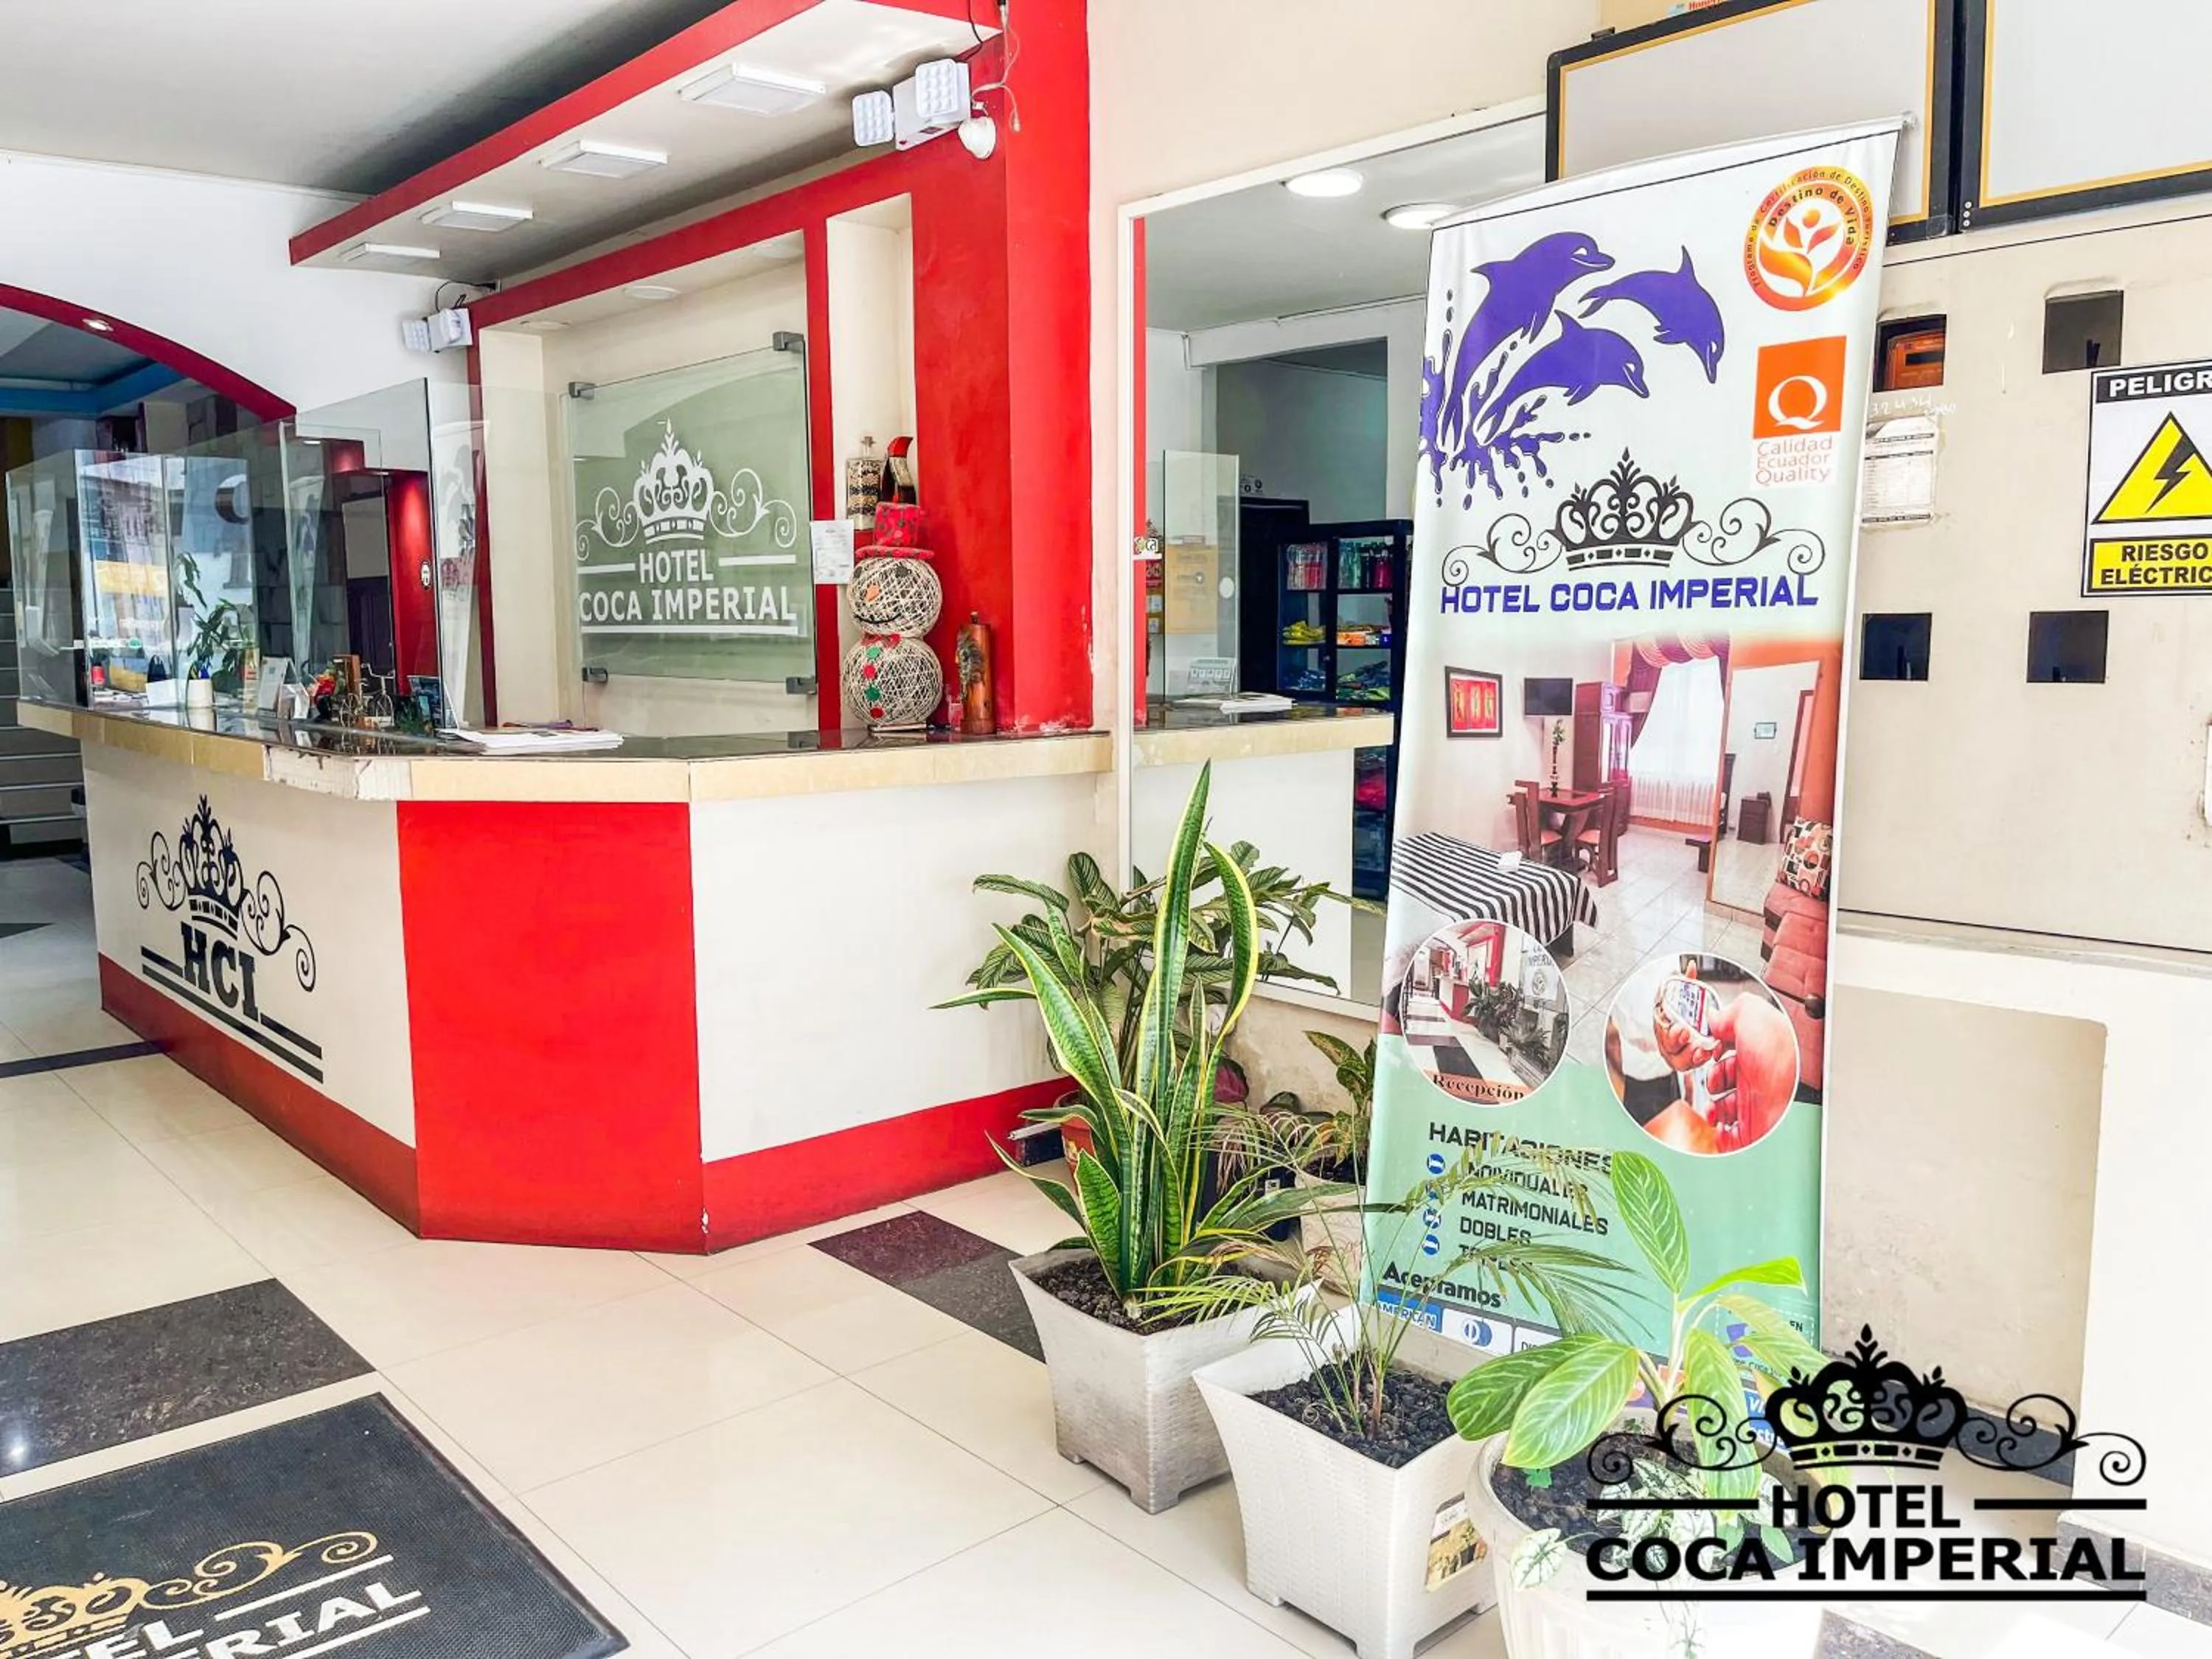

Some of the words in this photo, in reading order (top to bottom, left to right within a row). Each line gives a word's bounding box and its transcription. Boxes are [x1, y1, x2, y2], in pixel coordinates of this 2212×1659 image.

[1768, 187, 1824, 228] Destino
[1829, 189, 1844, 205] de
[1844, 206, 1858, 246] Vida
[1768, 375, 1828, 430] Q
[1756, 435, 1834, 456] Calidad
[1756, 453, 1831, 470] Ecuador
[1755, 466, 1832, 487] Quality
[639, 548, 714, 584] HOTEL
[2121, 542, 2209, 562] RIESGO
[580, 588, 643, 623] COCA
[652, 585, 797, 621] IMPERIAL
[1440, 585, 1541, 614] HOTEL
[1550, 580, 1639, 611] COCA
[1649, 574, 1819, 611] IMPERIAL
[180, 922, 259, 1023] HCI
[1433, 1074, 1525, 1101] Recepción
[1459, 1216, 1532, 1246] DOBLES
[1461, 1191, 1609, 1237] MATRIMONIALES
